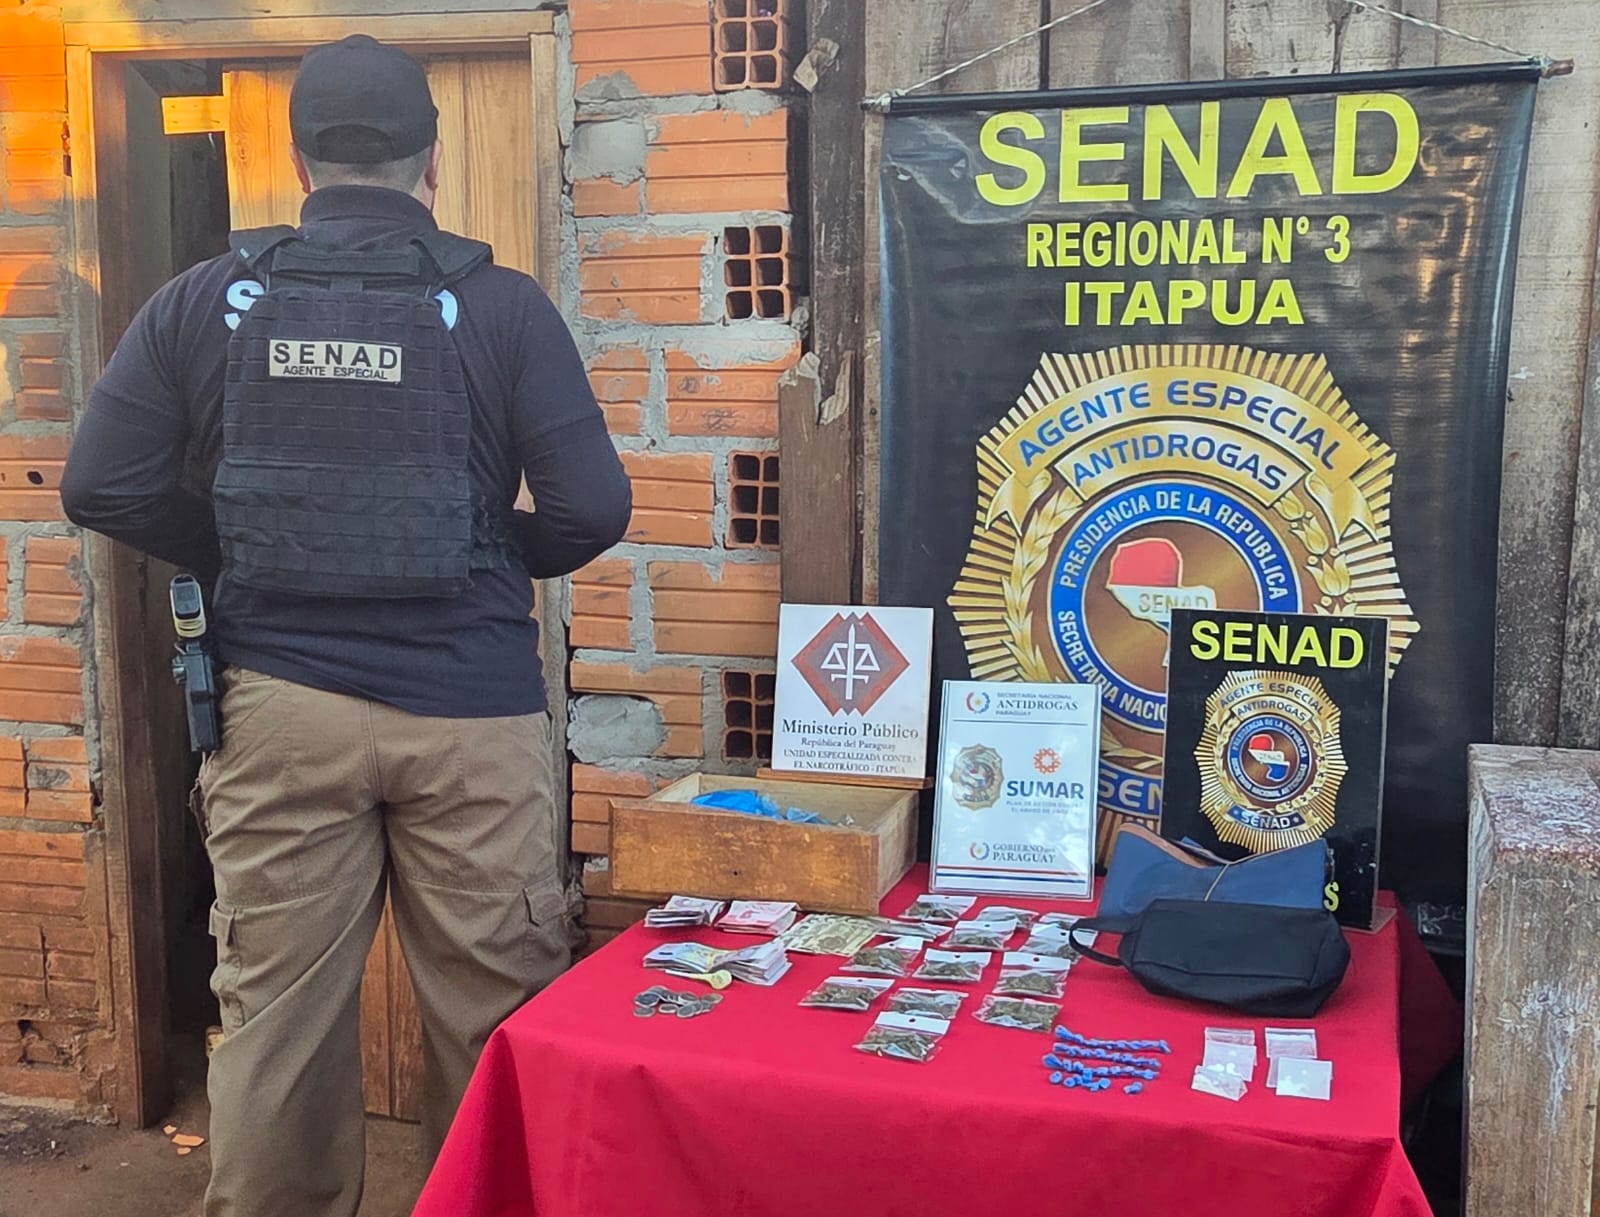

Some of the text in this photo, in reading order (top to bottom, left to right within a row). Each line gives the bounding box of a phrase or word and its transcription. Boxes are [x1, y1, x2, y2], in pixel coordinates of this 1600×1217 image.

[975, 93, 1421, 205] SENAD
[1027, 219, 1247, 267] REGIONAL
[1325, 215, 1350, 263] 3
[1065, 279, 1304, 325] ITAPUA
[273, 342, 398, 369] SENAD
[283, 366, 388, 380] AGENTE ESPECIAL
[1018, 380, 1341, 470] AGENTE ESPECIAL
[1072, 434, 1288, 491] ANTIDROGAS
[1060, 491, 1288, 600] PRESIDENCIA DE LA REPUBLICA
[1190, 620, 1365, 668] SENAD
[1058, 610, 1119, 703] SECRETARIA
[996, 699, 1078, 711] ANTIDROGAS
[1220, 683, 1324, 715] AGENTE ESPECIAL
[1236, 700, 1307, 721] ANTIDROGAS
[782, 719, 919, 739] Ministerio Público
[784, 749, 816, 759] UNIDAD
[818, 751, 881, 763] ESPECIALIZADA
[844, 740, 856, 749] del
[859, 741, 896, 757] Paraguay
[794, 761, 804, 769] EL
[1006, 780, 1085, 800] SUMAR
[1241, 811, 1290, 829] SENAD
[992, 843, 1043, 853] GOBIERNO
[992, 851, 1056, 863] PARAGUAY
